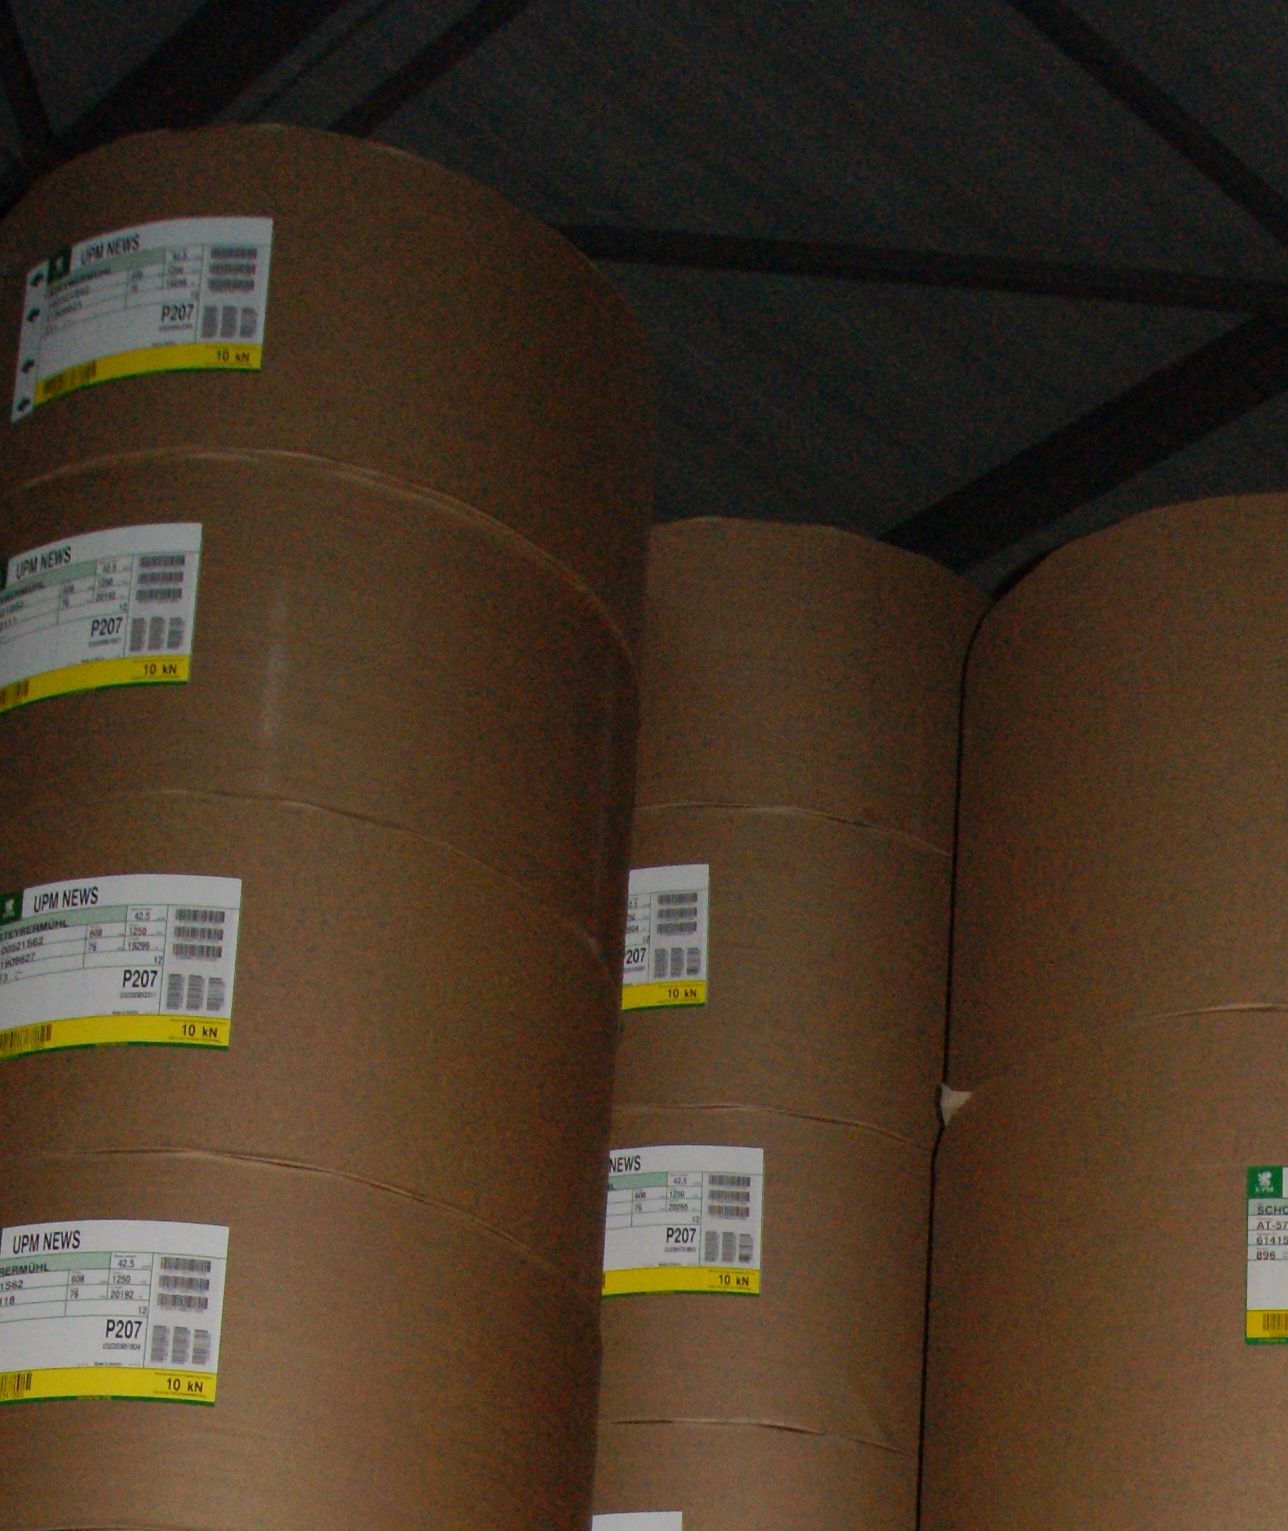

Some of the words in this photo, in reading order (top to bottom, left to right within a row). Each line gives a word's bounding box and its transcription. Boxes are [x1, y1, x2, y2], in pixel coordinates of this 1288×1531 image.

[16, 555, 37, 579] UPM
[41, 545, 71, 568] NEWS
[91, 617, 123, 637] P207
[33, 893, 59, 913] UPM
[62, 887, 99, 907] NEWS
[123, 970, 158, 987] P207
[609, 1155, 640, 1173] NEWS
[13, 1234, 39, 1254] UPM
[43, 1230, 80, 1250] NEWS
[666, 1228, 696, 1243] P207
[118, 1260, 134, 1268] 42.5
[113, 1275, 131, 1284] 1250
[720, 1275, 730, 1284] 10
[736, 1277, 749, 1285] kN
[106, 1320, 142, 1339] P207
[167, 1378, 181, 1391] 10
[188, 1382, 203, 1392] kN
